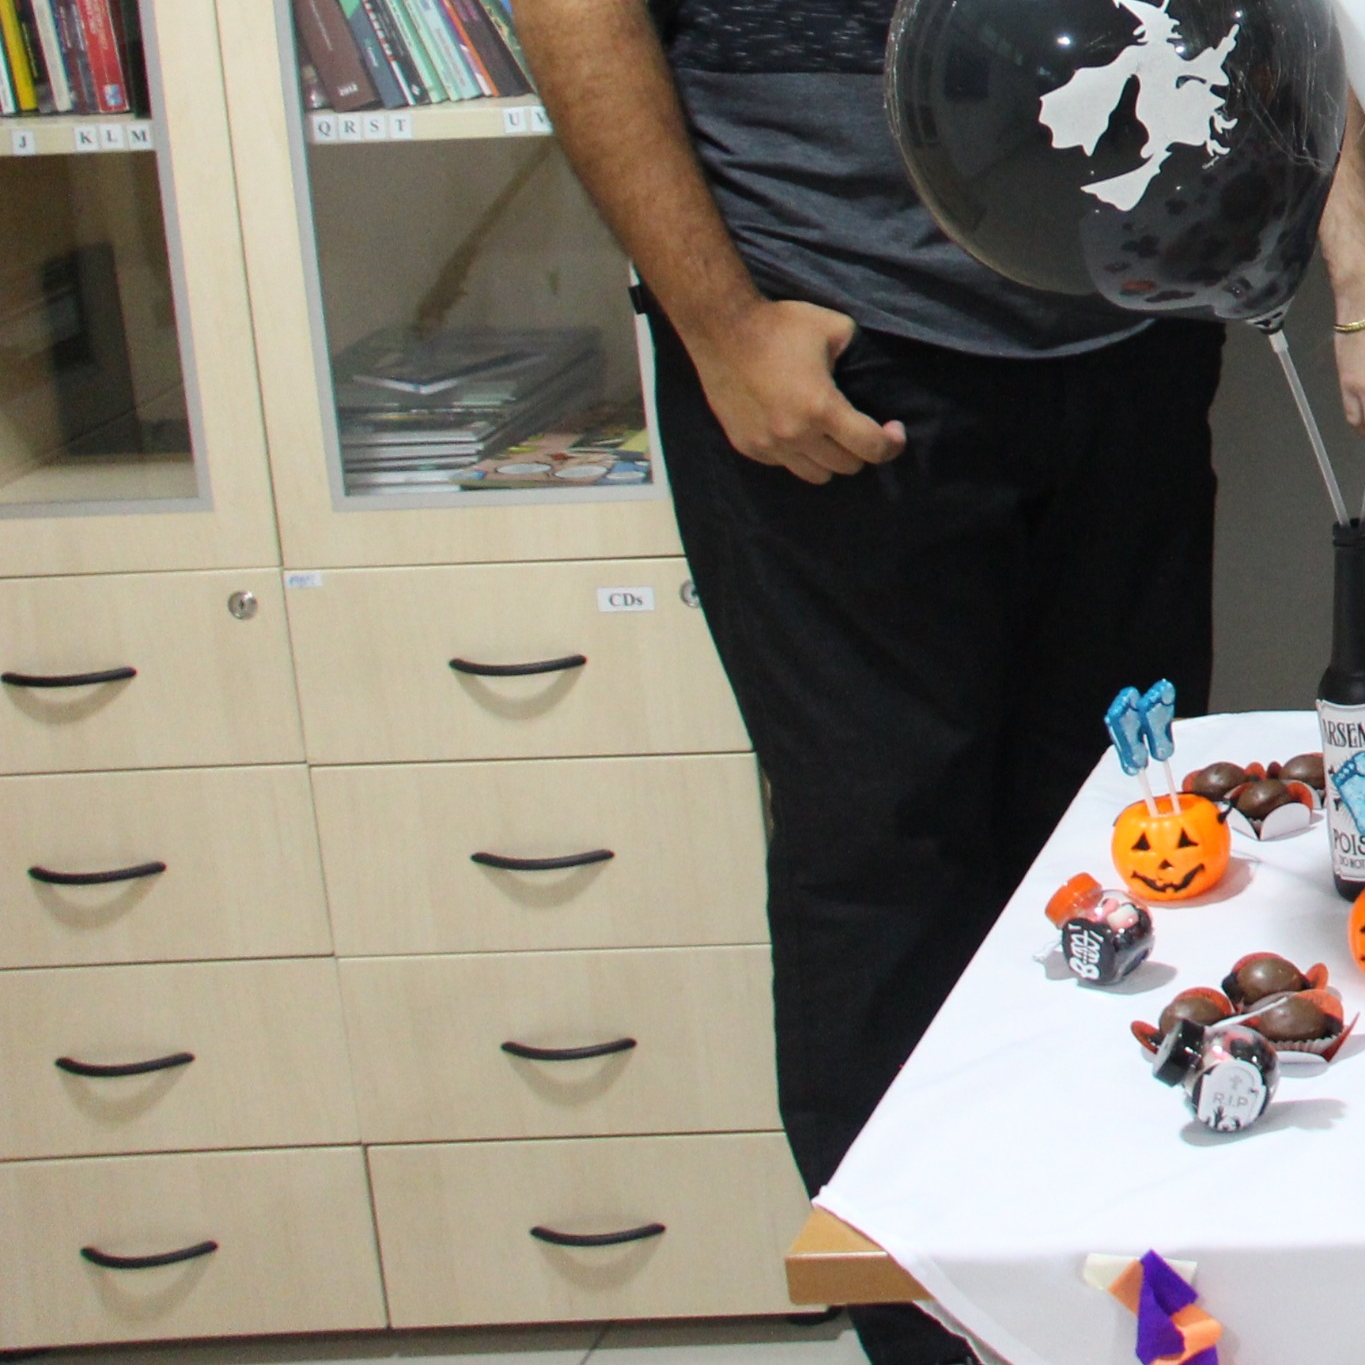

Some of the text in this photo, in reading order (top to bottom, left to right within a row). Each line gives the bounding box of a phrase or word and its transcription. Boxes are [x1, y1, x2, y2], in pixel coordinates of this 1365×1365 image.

[370, 119, 379, 133] S
[395, 118, 406, 132] T
[508, 113, 521, 127] U
[318, 121, 331, 136] Q
[343, 121, 357, 134] R
[19, 136, 26, 148] J
[79, 132, 92, 144] K
[106, 130, 117, 143] L
[132, 130, 147, 143] M
[609, 592, 643, 608] CDs
